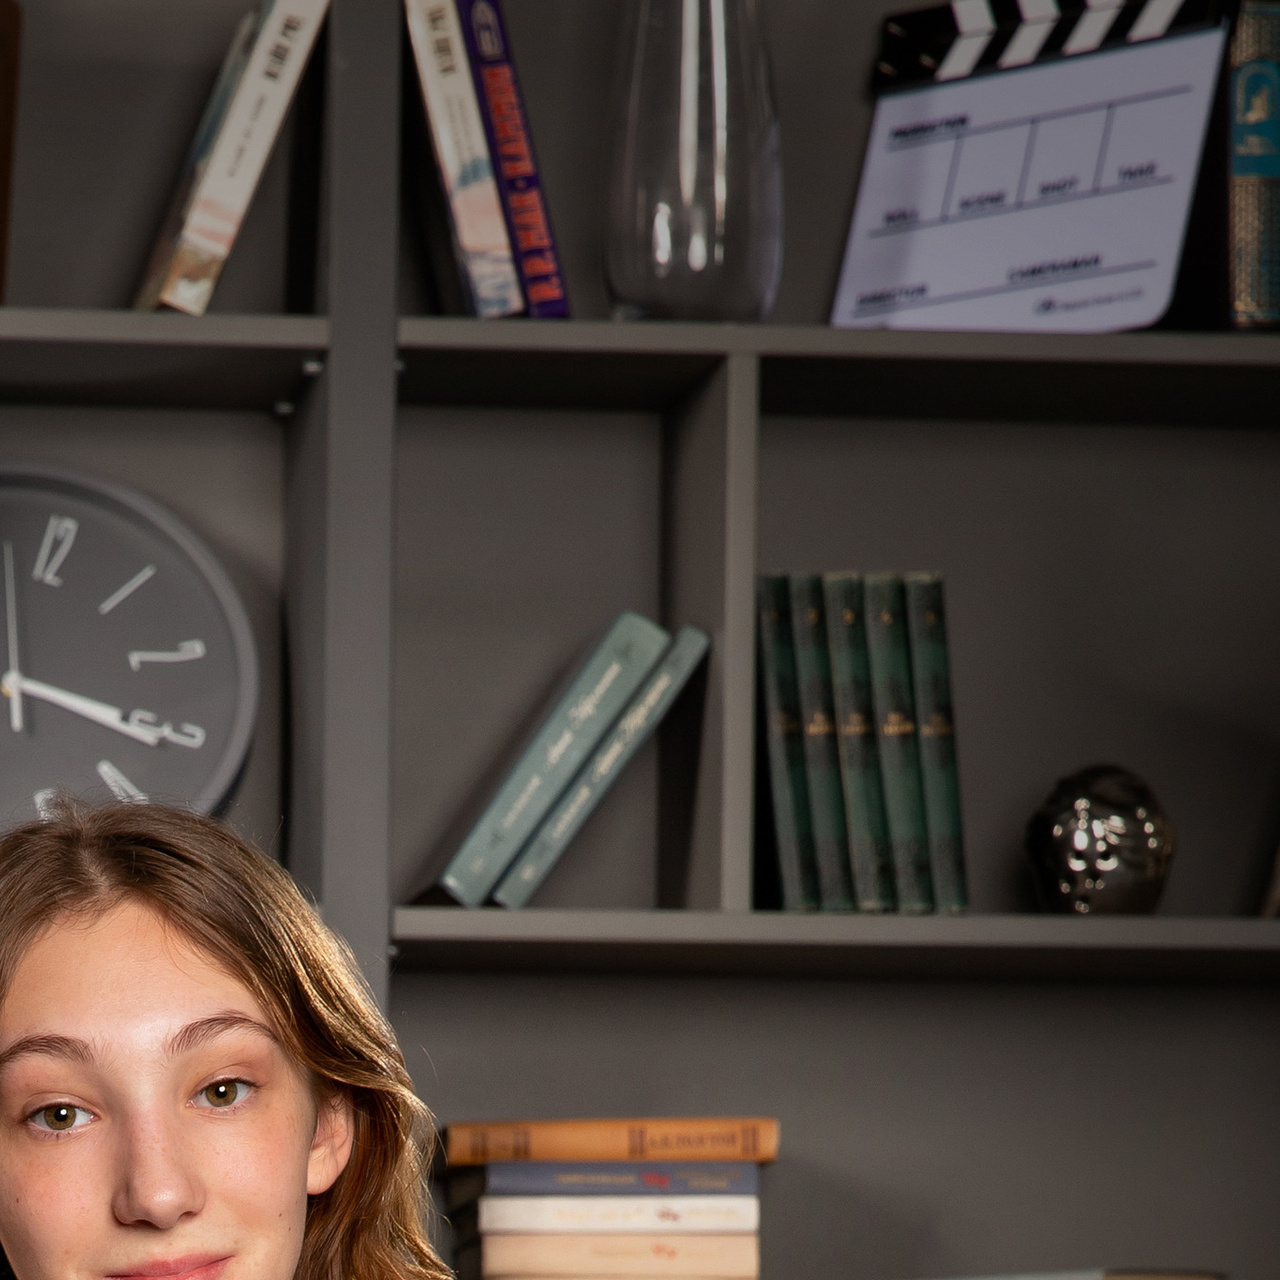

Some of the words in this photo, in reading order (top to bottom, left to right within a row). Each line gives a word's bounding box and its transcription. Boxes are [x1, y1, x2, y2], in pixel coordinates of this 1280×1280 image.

[31, 514, 79, 588] 12
[97, 563, 157, 615] 1
[127, 638, 207, 672] 2
[128, 708, 207, 749] 3
